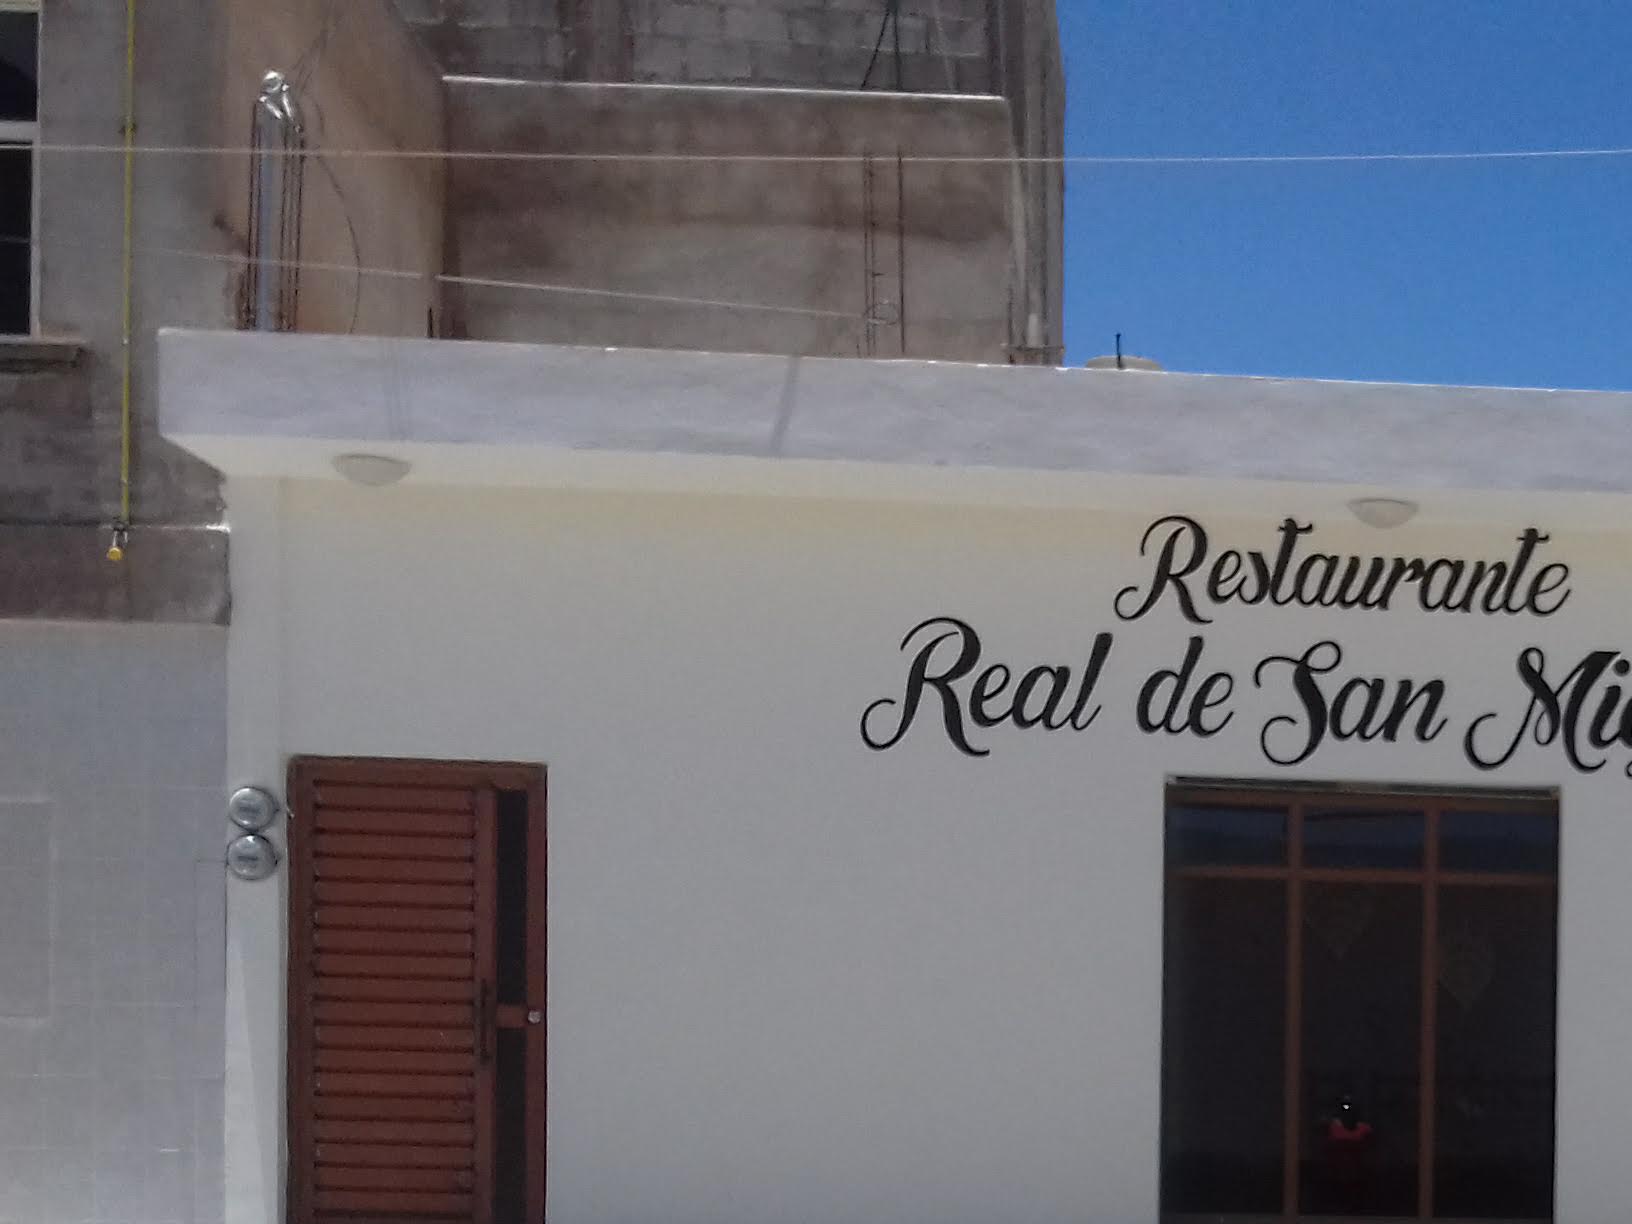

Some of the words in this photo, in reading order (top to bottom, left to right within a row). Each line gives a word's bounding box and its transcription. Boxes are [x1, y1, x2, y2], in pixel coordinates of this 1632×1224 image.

[1113, 514, 1573, 626] Restaurante
[859, 616, 1114, 758] Real
[1135, 634, 1236, 740] de
[1252, 639, 1449, 768] San
